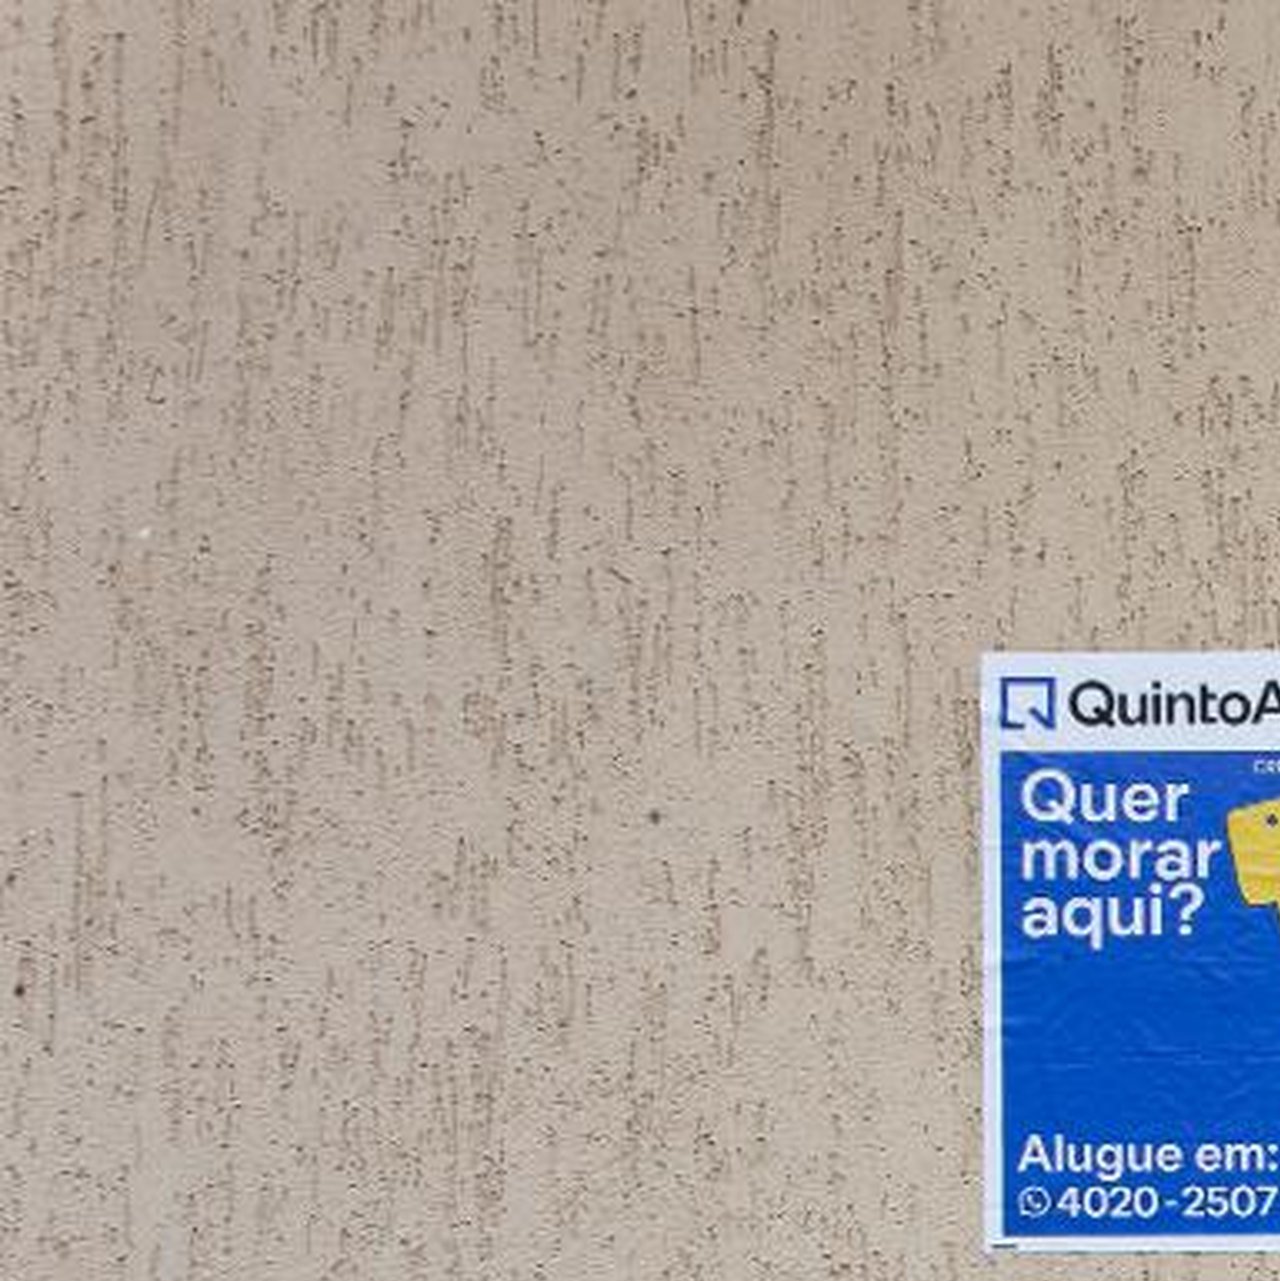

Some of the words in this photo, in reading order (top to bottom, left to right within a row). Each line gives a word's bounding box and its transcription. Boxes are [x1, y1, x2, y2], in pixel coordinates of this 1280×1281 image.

[1020, 768, 1189, 824] Quer
[1021, 838, 1222, 881] morar
[1021, 883, 1205, 950] aqui?
[1017, 1134, 1183, 1181] Alugue
[1195, 1143, 1278, 1172] em:
[1056, 1186, 1279, 1218] 4020-2507
